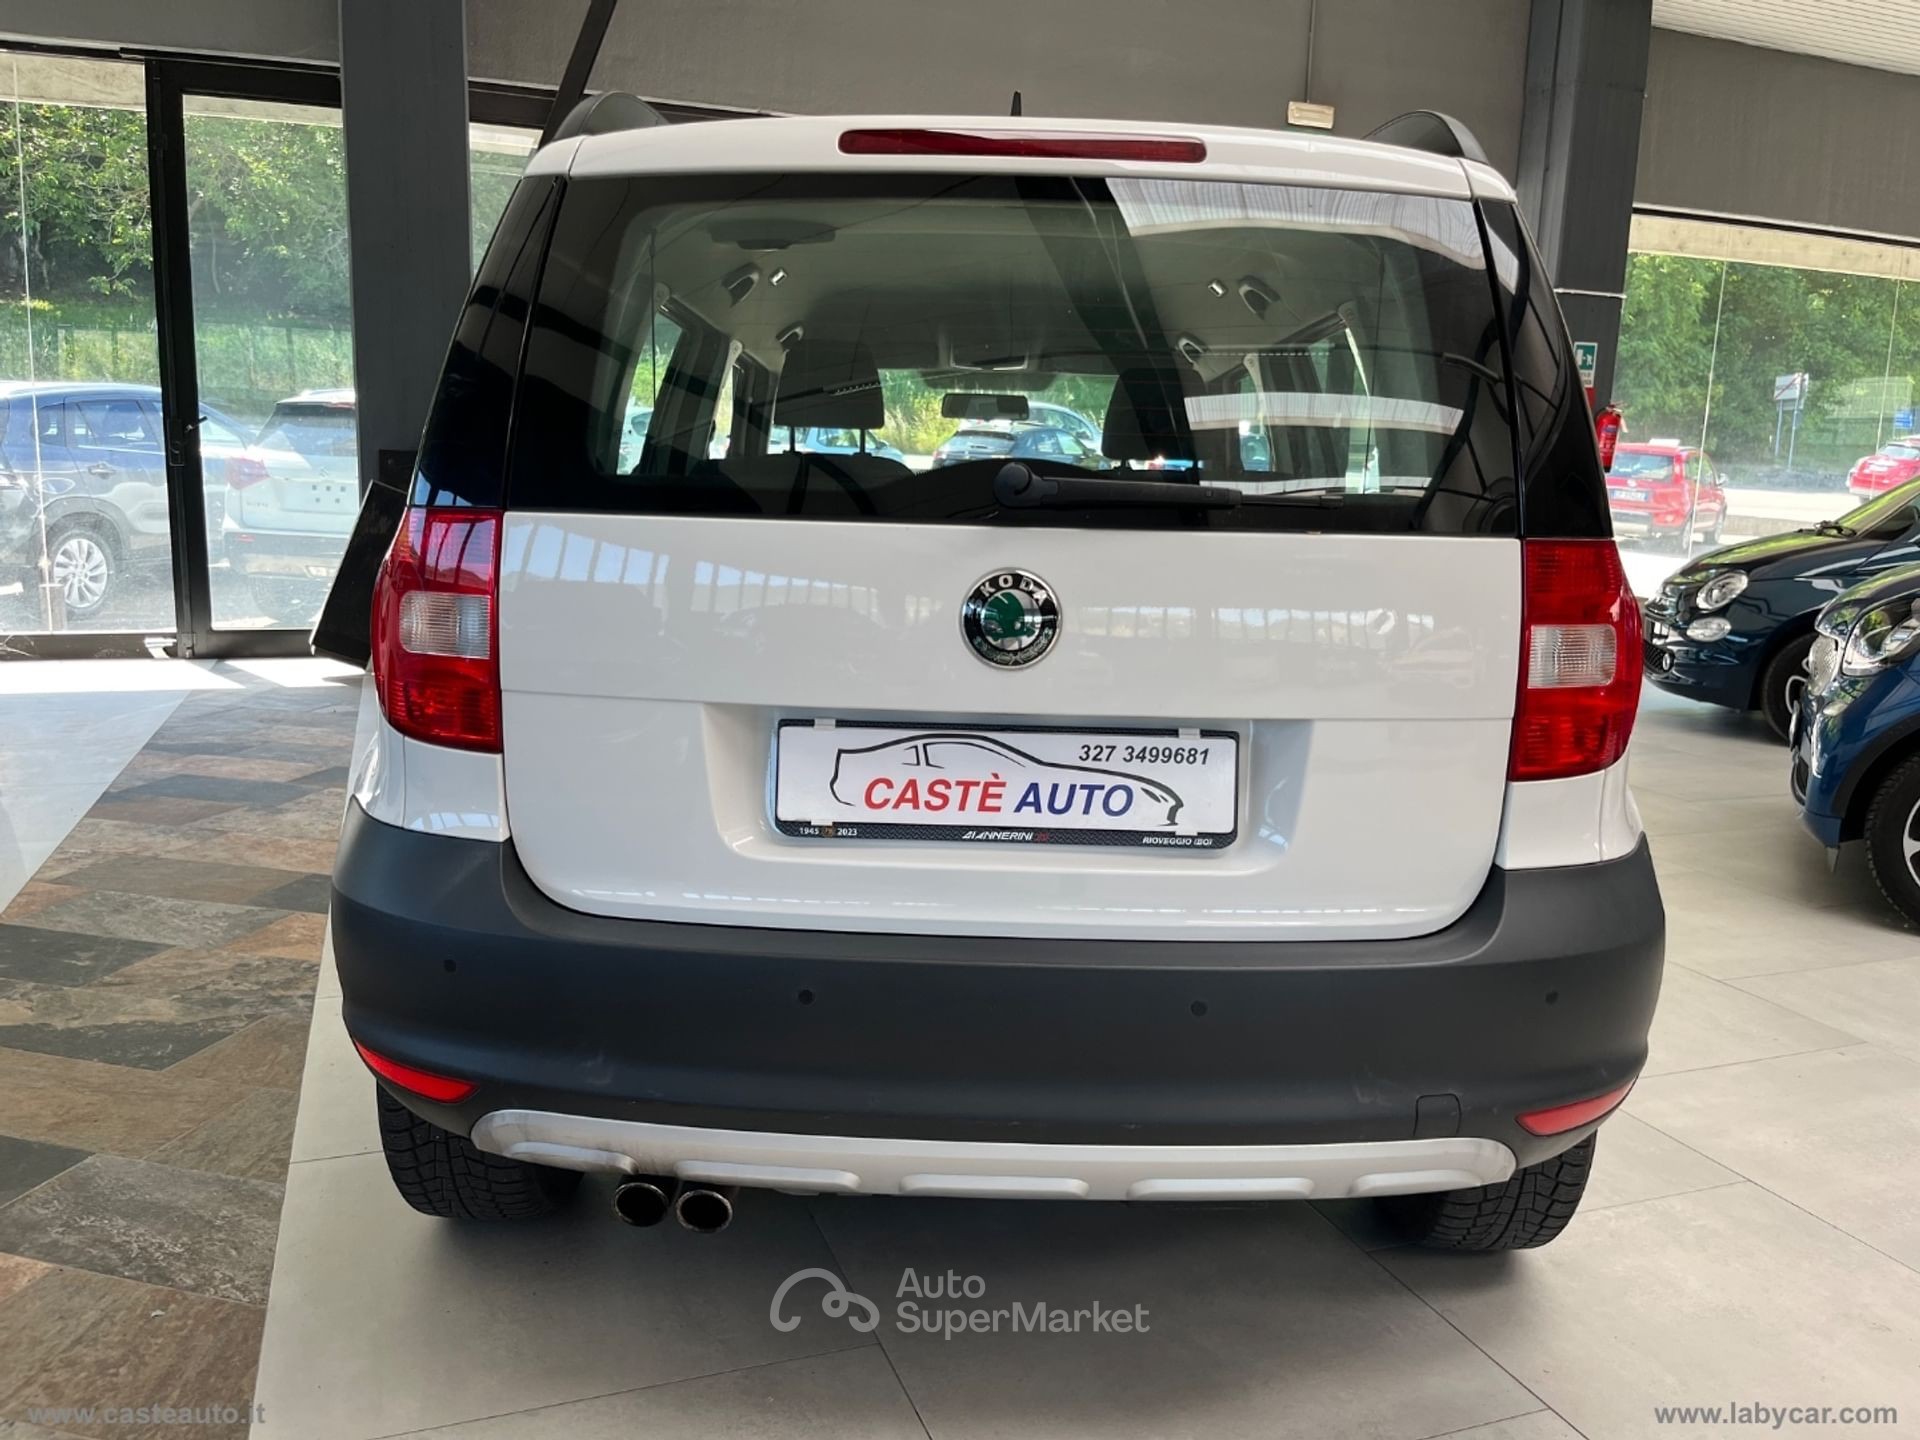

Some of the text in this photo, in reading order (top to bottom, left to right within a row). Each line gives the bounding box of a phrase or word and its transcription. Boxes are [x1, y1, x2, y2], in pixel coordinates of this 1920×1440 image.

[966, 573, 1048, 615] KODA
[1079, 744, 1209, 765] 327 3499681
[864, 772, 1134, 817] CASTÈ AUTO
[837, 828, 857, 836] 2023
